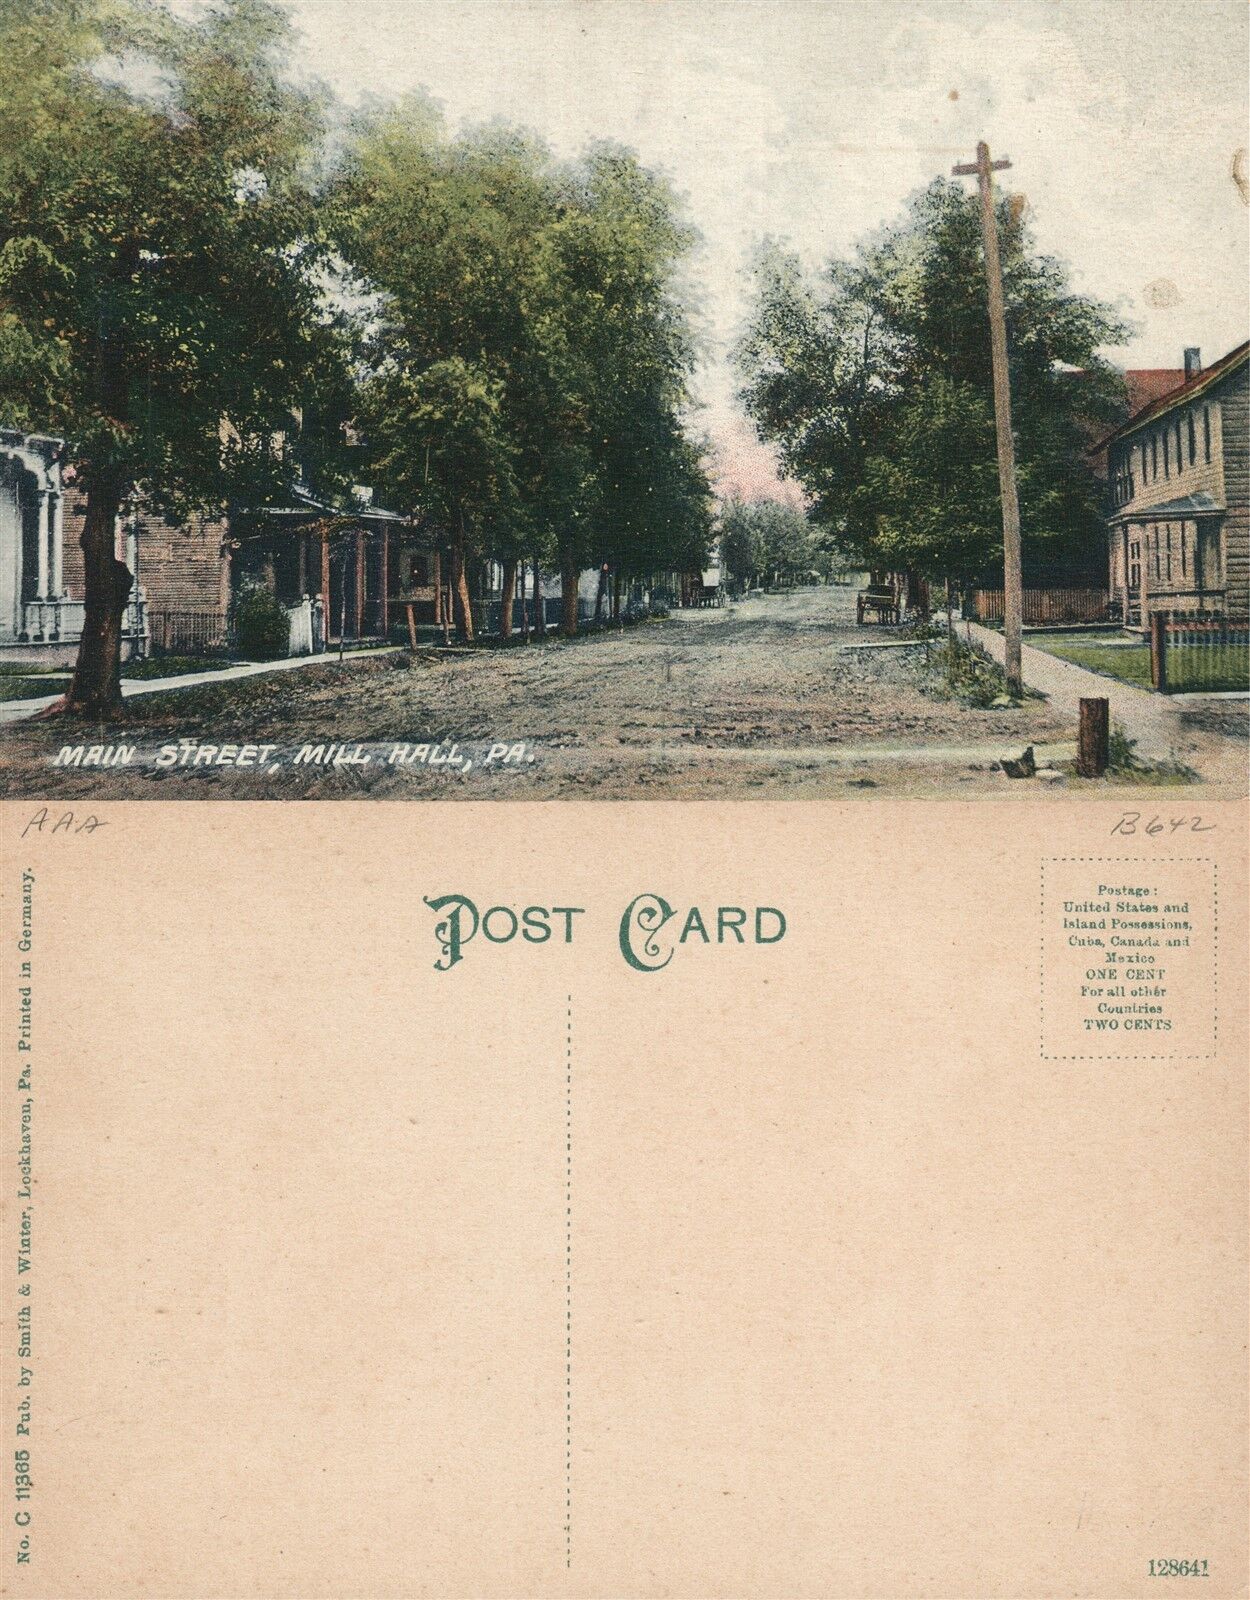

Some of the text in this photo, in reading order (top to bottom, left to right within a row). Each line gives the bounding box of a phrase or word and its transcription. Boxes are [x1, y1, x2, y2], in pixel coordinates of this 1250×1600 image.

[1063, 901, 1189, 913] United States and
[1063, 918, 1193, 931] Island Possessions,
[1068, 935, 1190, 948] Cuba, Canada and
[1105, 952, 1155, 963] Mexico
[1086, 969, 1166, 980] ONE CENT
[1081, 986, 1166, 997] For all other
[1097, 1003, 1163, 1014] Countries
[1084, 1019, 1172, 1030] TWO CENTS
[15, 867, 35, 1565] No. C 11365 Pub. by Smith & Winter, Lockhaven, Pa. Printed in Germany.
[1147, 1558, 1211, 1577] 128641
